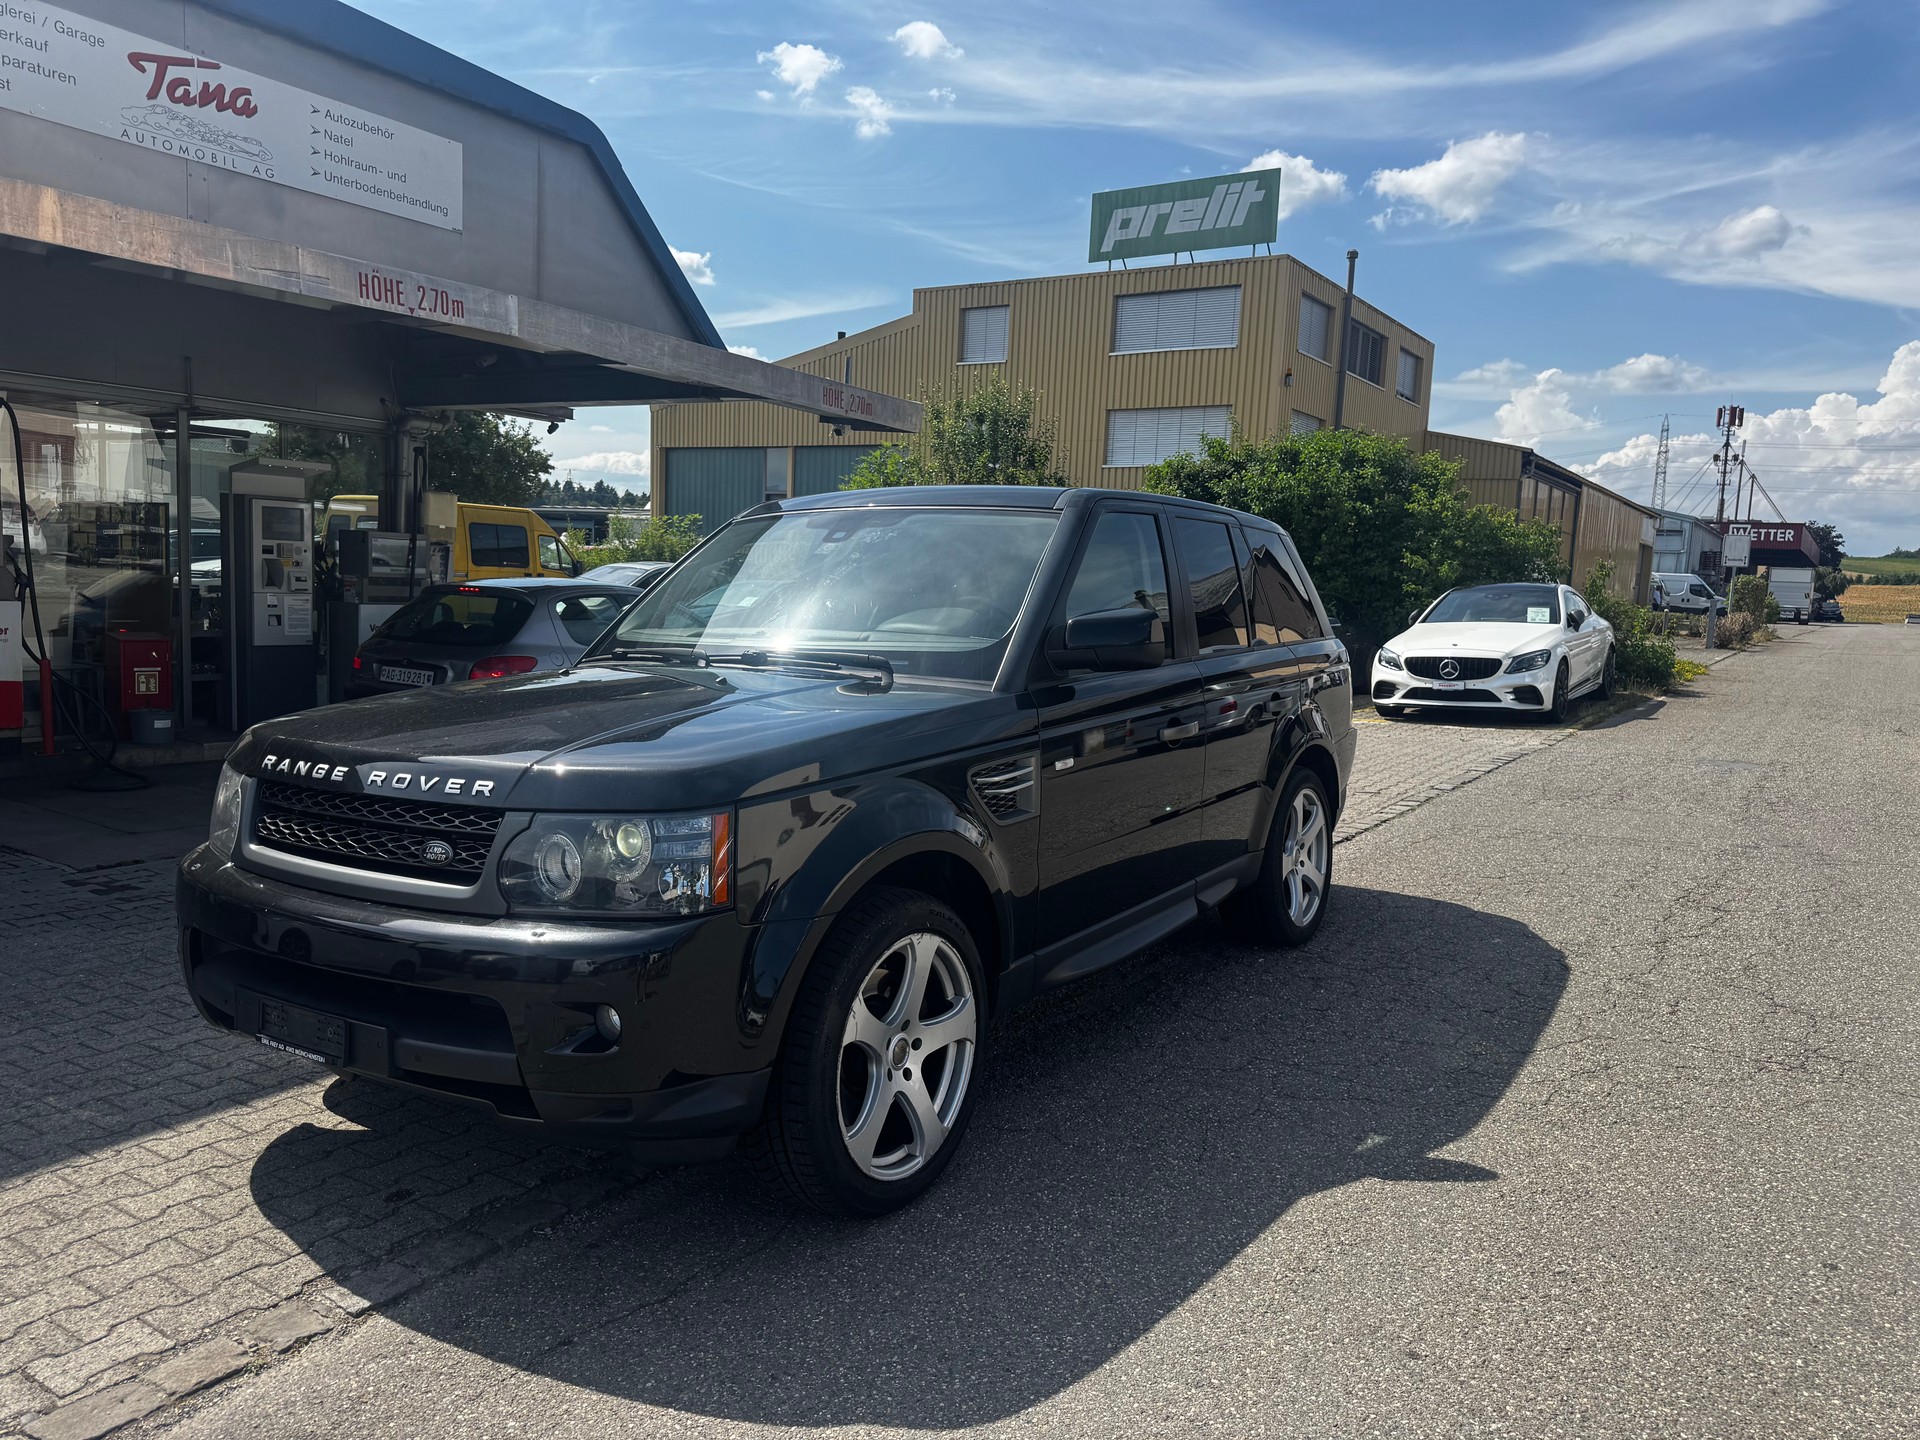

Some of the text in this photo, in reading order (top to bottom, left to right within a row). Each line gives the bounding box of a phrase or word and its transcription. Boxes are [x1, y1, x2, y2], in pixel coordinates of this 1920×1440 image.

[54, 20, 105, 47] Garage
[0, 54, 77, 86] paraturen
[127, 52, 258, 118] Tana
[324, 109, 395, 140] Autozubehör
[324, 129, 354, 147] Natel
[120, 128, 275, 179] AUTOMOBIL AG
[324, 149, 407, 183] Hohlraum- und
[324, 170, 449, 217] Unterbodenbehandlung
[1100, 179, 1266, 253] prelit
[358, 269, 405, 306] HÖHE
[261, 754, 496, 797] RANGE ROVER
[426, 852, 446, 861] ROVER
